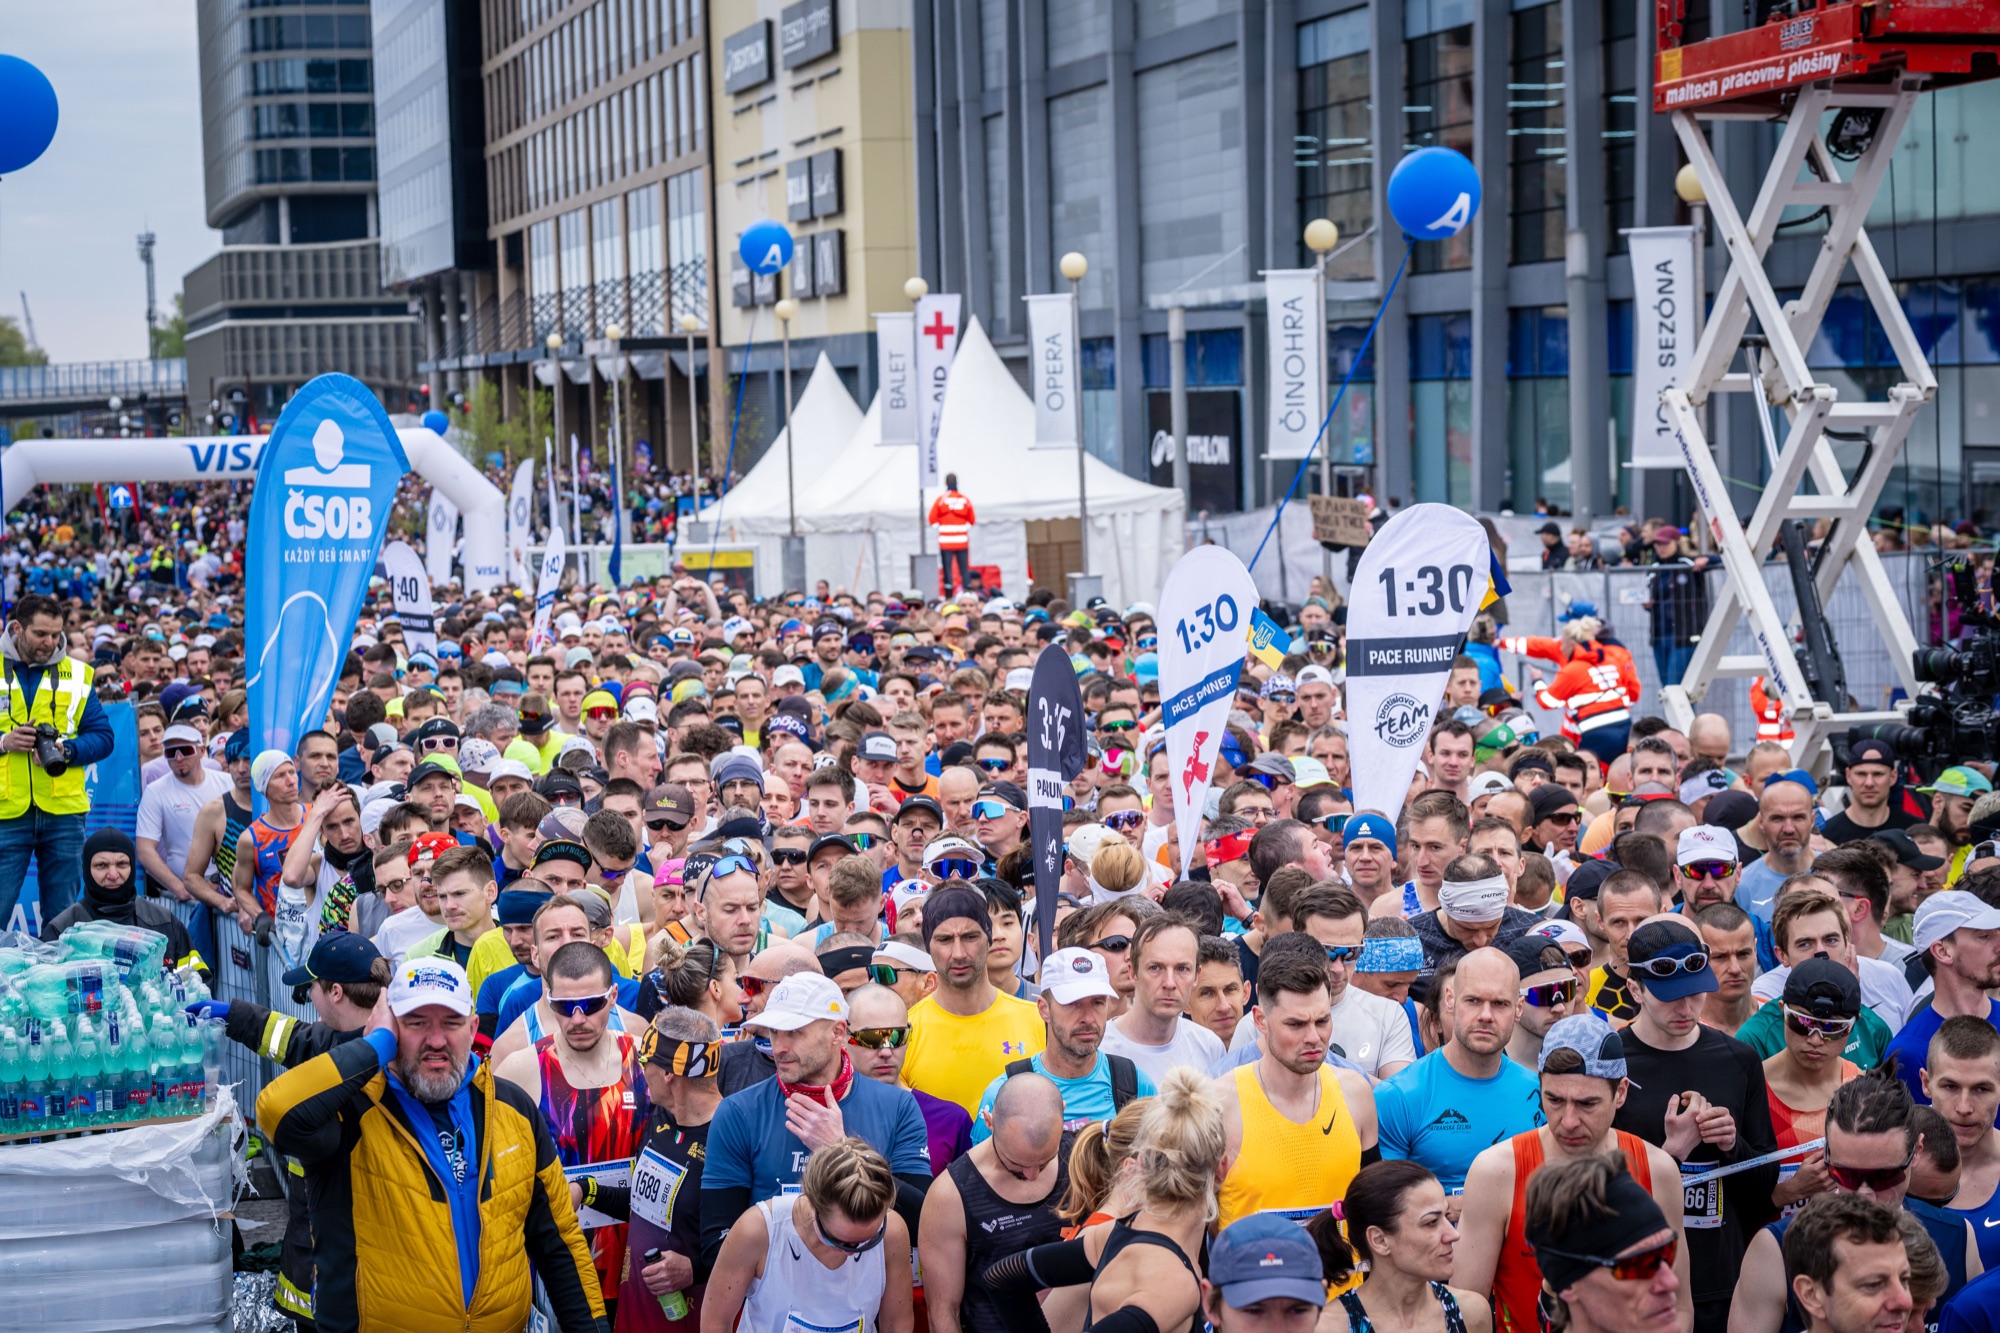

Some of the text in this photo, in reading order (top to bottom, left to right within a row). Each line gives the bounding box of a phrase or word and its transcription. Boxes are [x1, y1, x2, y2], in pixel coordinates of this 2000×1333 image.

[1665, 51, 1842, 104] maltech pracovné plošiny
[1654, 259, 1677, 368] SEZÓNA
[889, 351, 906, 410] BALET
[1045, 332, 1065, 412] OPERA
[1278, 296, 1307, 433] ČINOHRA
[284, 487, 373, 540] ČSOB
[284, 547, 371, 563] KAŽDÝ DEŇ SMART
[475, 566, 500, 576] VISA
[389, 575, 418, 603] 1:40
[1379, 564, 1474, 617] 1:30
[1176, 594, 1239, 654] 1:30
[1369, 649, 1402, 665] PACE
[1171, 695, 1196, 717] PACE
[1374, 703, 1430, 739] TEAM
[1378, 695, 1415, 719] bratislava
[1388, 720, 1426, 746] marathon
[635, 1169, 661, 1203] 1589
